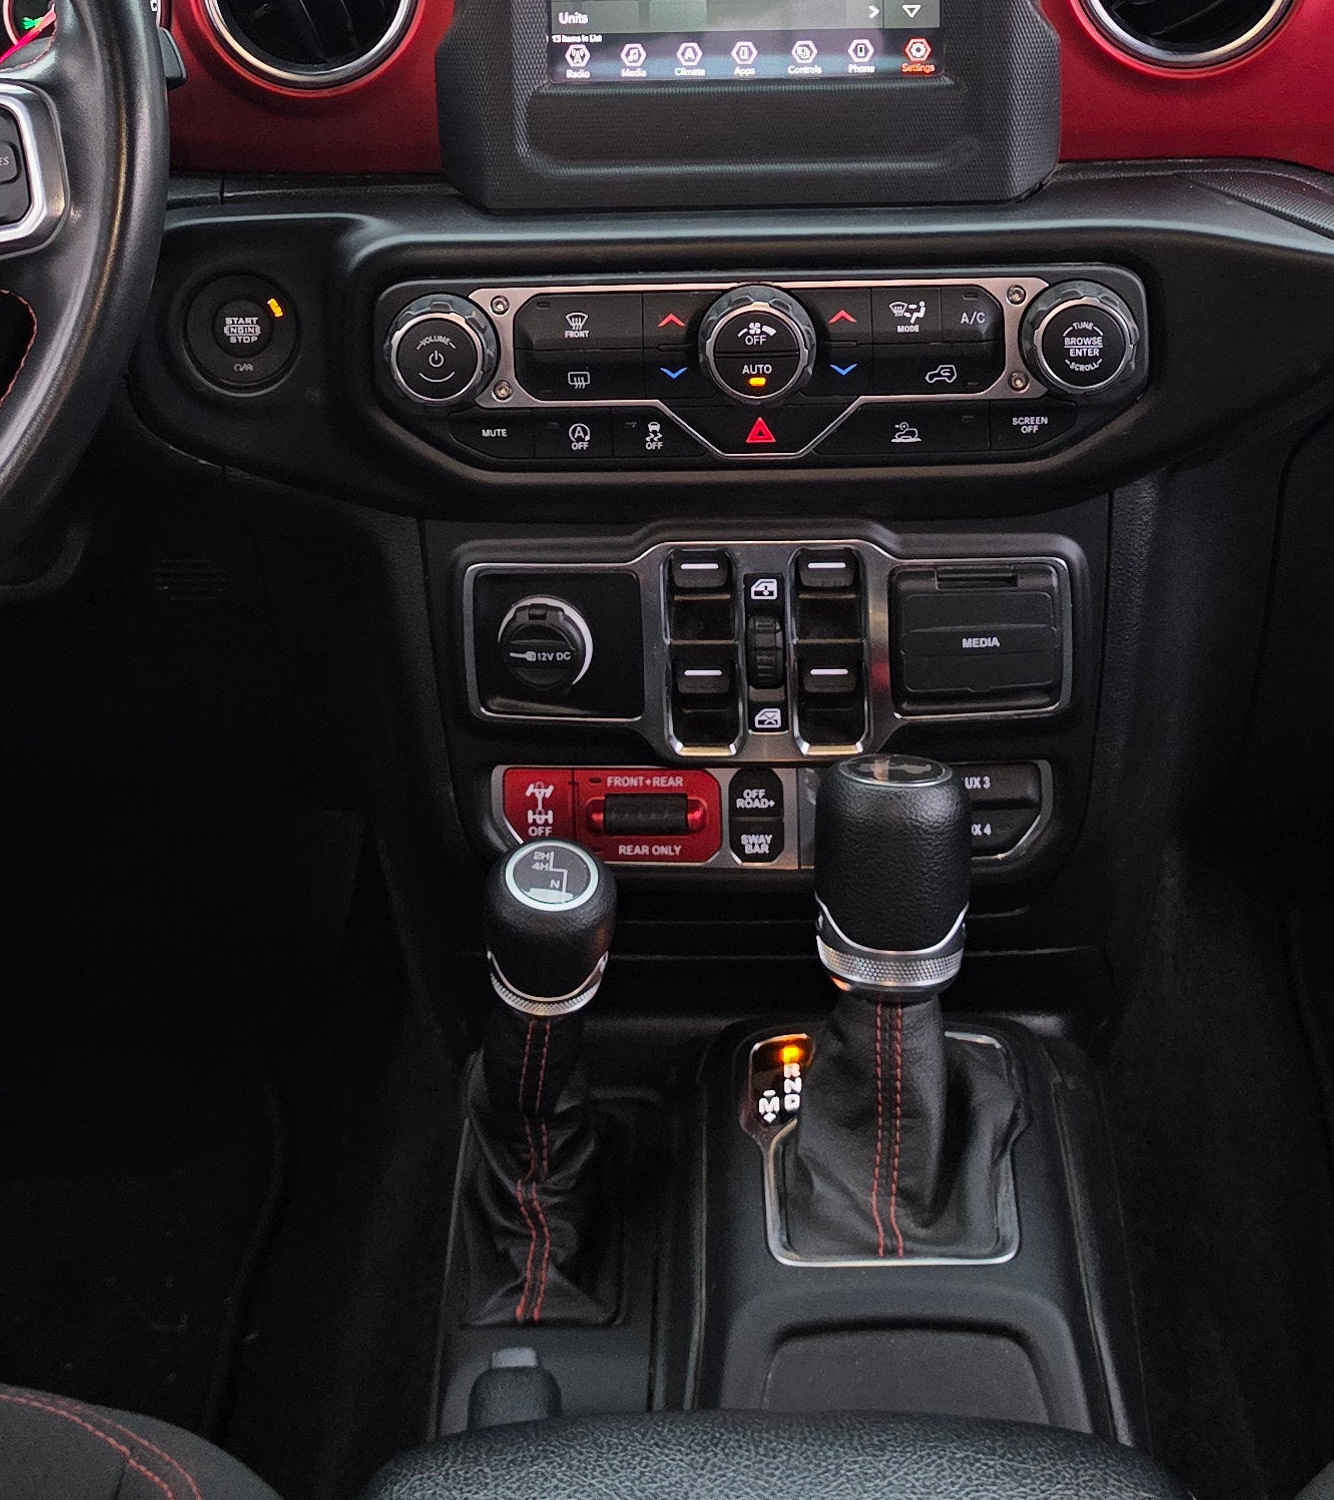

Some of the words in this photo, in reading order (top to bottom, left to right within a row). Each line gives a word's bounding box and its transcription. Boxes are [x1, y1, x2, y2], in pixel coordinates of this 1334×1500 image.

[558, 12, 588, 25] Units
[566, 68, 590, 79] Radio
[621, 68, 647, 77] Media
[675, 67, 705, 77] Climate
[734, 66, 756, 77] Apps
[788, 64, 822, 75] Controls
[848, 63, 875, 73] Phone
[901, 63, 935, 73] Settings
[225, 317, 259, 325] START
[960, 311, 986, 325] A/C
[896, 324, 920, 334] MODE
[1072, 321, 1094, 332] TUNE
[564, 329, 589, 339] FRONT
[229, 336, 258, 344] STOP
[419, 335, 451, 346] VOLUME
[744, 334, 767, 346] OFF
[1064, 336, 1103, 347] BROWSE
[1069, 347, 1100, 358] ENTER
[742, 363, 773, 375] AUTO
[1069, 361, 1100, 372] SCROLL
[1012, 416, 1049, 426] SCREEN
[482, 428, 508, 438] MUTE
[1020, 424, 1039, 434] OFF
[571, 440, 589, 451] OFF
[645, 440, 664, 451] OFF
[961, 636, 1000, 649] MEDIA
[536, 649, 556, 663] 12V
[557, 649, 572, 663] DC
[982, 776, 991, 789] 3
[742, 788, 766, 800] OFF
[736, 798, 776, 809] ROAD+
[528, 826, 553, 837] OFF
[740, 834, 773, 845] SWAY
[618, 845, 650, 856] REAR
[651, 845, 682, 856] ONLY
[744, 844, 769, 855] BAR
[533, 852, 550, 862] 2H
[532, 861, 550, 871] 4H
[550, 879, 561, 889] N
[784, 1077, 802, 1094] N
[758, 1096, 780, 1115] M
